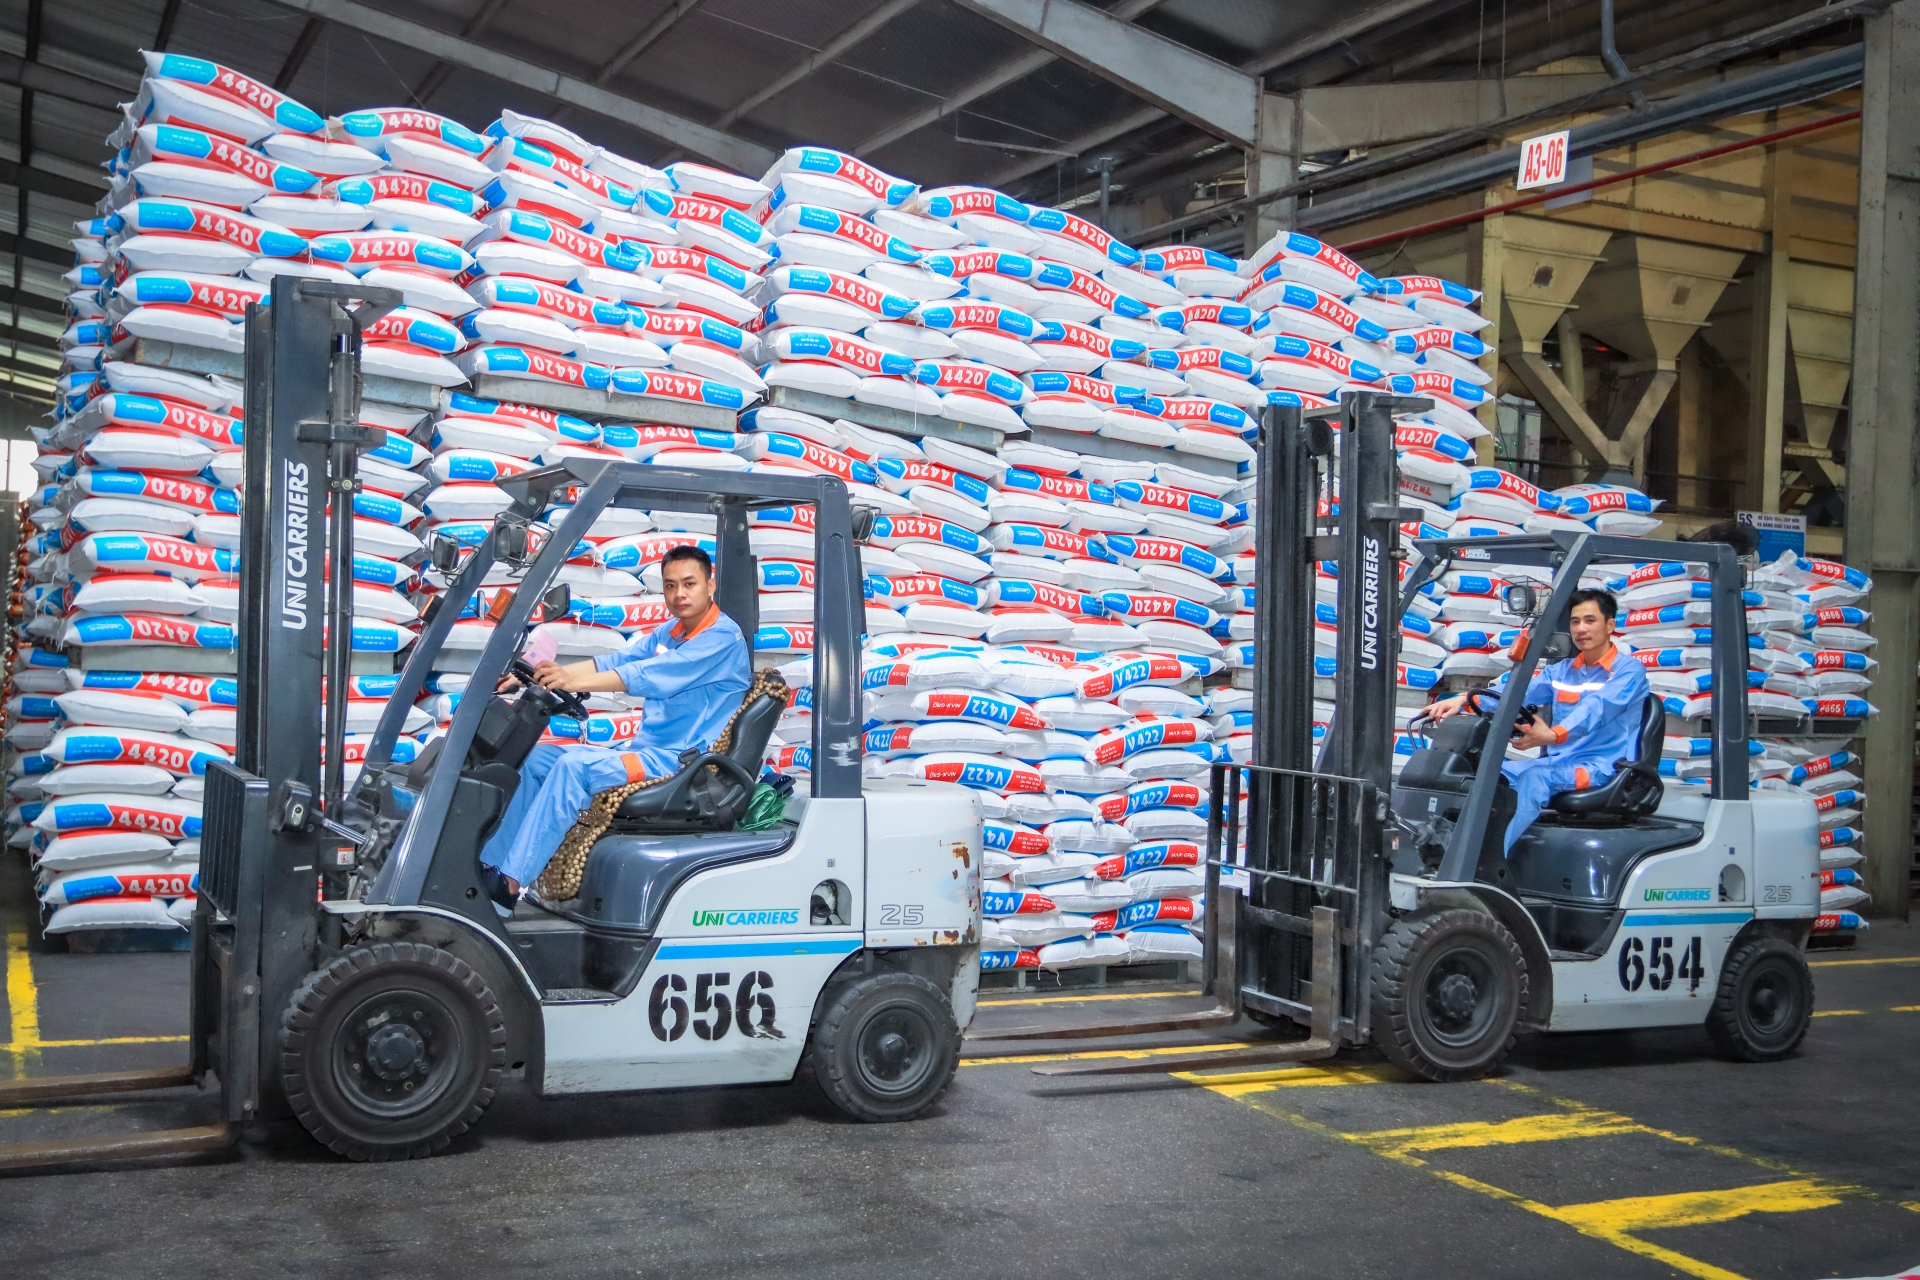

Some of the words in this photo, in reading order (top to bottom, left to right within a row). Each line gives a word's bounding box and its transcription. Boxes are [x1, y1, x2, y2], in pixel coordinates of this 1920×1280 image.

[221, 72, 273, 109] 4420
[388, 113, 437, 131] 4420
[216, 144, 268, 179] 4420
[1523, 137, 1564, 184] A3-06
[560, 158, 606, 189] 4420
[844, 162, 885, 194] 4420
[378, 179, 423, 199] 4420
[678, 200, 724, 220] 4420
[955, 193, 992, 210] 4420
[199, 213, 254, 246] 4420
[843, 219, 883, 248] 4420
[1069, 218, 1106, 247] 4420
[357, 241, 410, 258] 4420
[555, 229, 601, 257] 4420
[657, 245, 702, 267] 4420
[957, 255, 994, 274] 4420
[1167, 249, 1201, 264] 4420
[1322, 246, 1356, 277] 4420
[835, 279, 877, 308] 4420
[1076, 276, 1111, 305] 4420
[1405, 278, 1439, 291] 4420
[197, 287, 252, 311] 4420
[543, 289, 588, 316] 4420
[652, 316, 697, 332] 4420
[957, 306, 995, 324] 4420
[1186, 307, 1217, 323] 4420
[1318, 301, 1354, 326] 4420
[366, 318, 404, 336] 420
[1069, 326, 1106, 353] 4420
[1417, 332, 1449, 347] 4420
[835, 341, 877, 367] 4420
[1181, 351, 1218, 367] 4420
[1312, 347, 1346, 370] 4420
[533, 355, 578, 381] 4420
[944, 364, 984, 386] 4420
[653, 376, 697, 396] 4420
[1072, 377, 1110, 399] 4420
[1417, 374, 1450, 388] 4420
[504, 401, 552, 423] 4420
[1167, 403, 1206, 418] 4420
[172, 408, 224, 438] 4420
[644, 425, 689, 439] 4420
[1398, 429, 1432, 445] 4420
[809, 446, 847, 472] 4420
[909, 463, 950, 481] 4420
[151, 480, 206, 505] 4420
[1045, 477, 1088, 495] 4420
[1504, 475, 1535, 499] 4420
[1147, 488, 1186, 508] 4420
[1592, 493, 1624, 508] 4420
[896, 519, 938, 535] 4420
[282, 458, 309, 630] UNICARRIERS
[1047, 531, 1087, 551] 4420
[1139, 542, 1180, 560] 4420
[153, 541, 208, 567] 4420
[896, 577, 940, 594] 4420
[1039, 587, 1077, 609] 4420
[1134, 599, 1172, 614] 4420
[1361, 536, 1379, 670] UNICARRIERS
[1629, 611, 1655, 622] 6666
[138, 619, 190, 643] 4420
[146, 672, 202, 696] 4420
[865, 664, 889, 686] V422
[1116, 664, 1148, 688] V422
[971, 700, 1008, 722] V422
[868, 731, 891, 749] V422
[1127, 728, 1160, 749] V422
[128, 744, 184, 768] 4420
[967, 766, 1004, 787] V422
[1131, 790, 1164, 810] V422
[117, 811, 175, 834] 4420
[1128, 850, 1162, 871] V422
[129, 879, 185, 893] 4420
[1764, 885, 1792, 902] 25
[982, 895, 1015, 912] V42
[1120, 903, 1155, 924] V422
[880, 904, 924, 925] 25
[980, 953, 1010, 968] V42
[1618, 936, 1704, 992] 654
[648, 970, 780, 1042] 656
